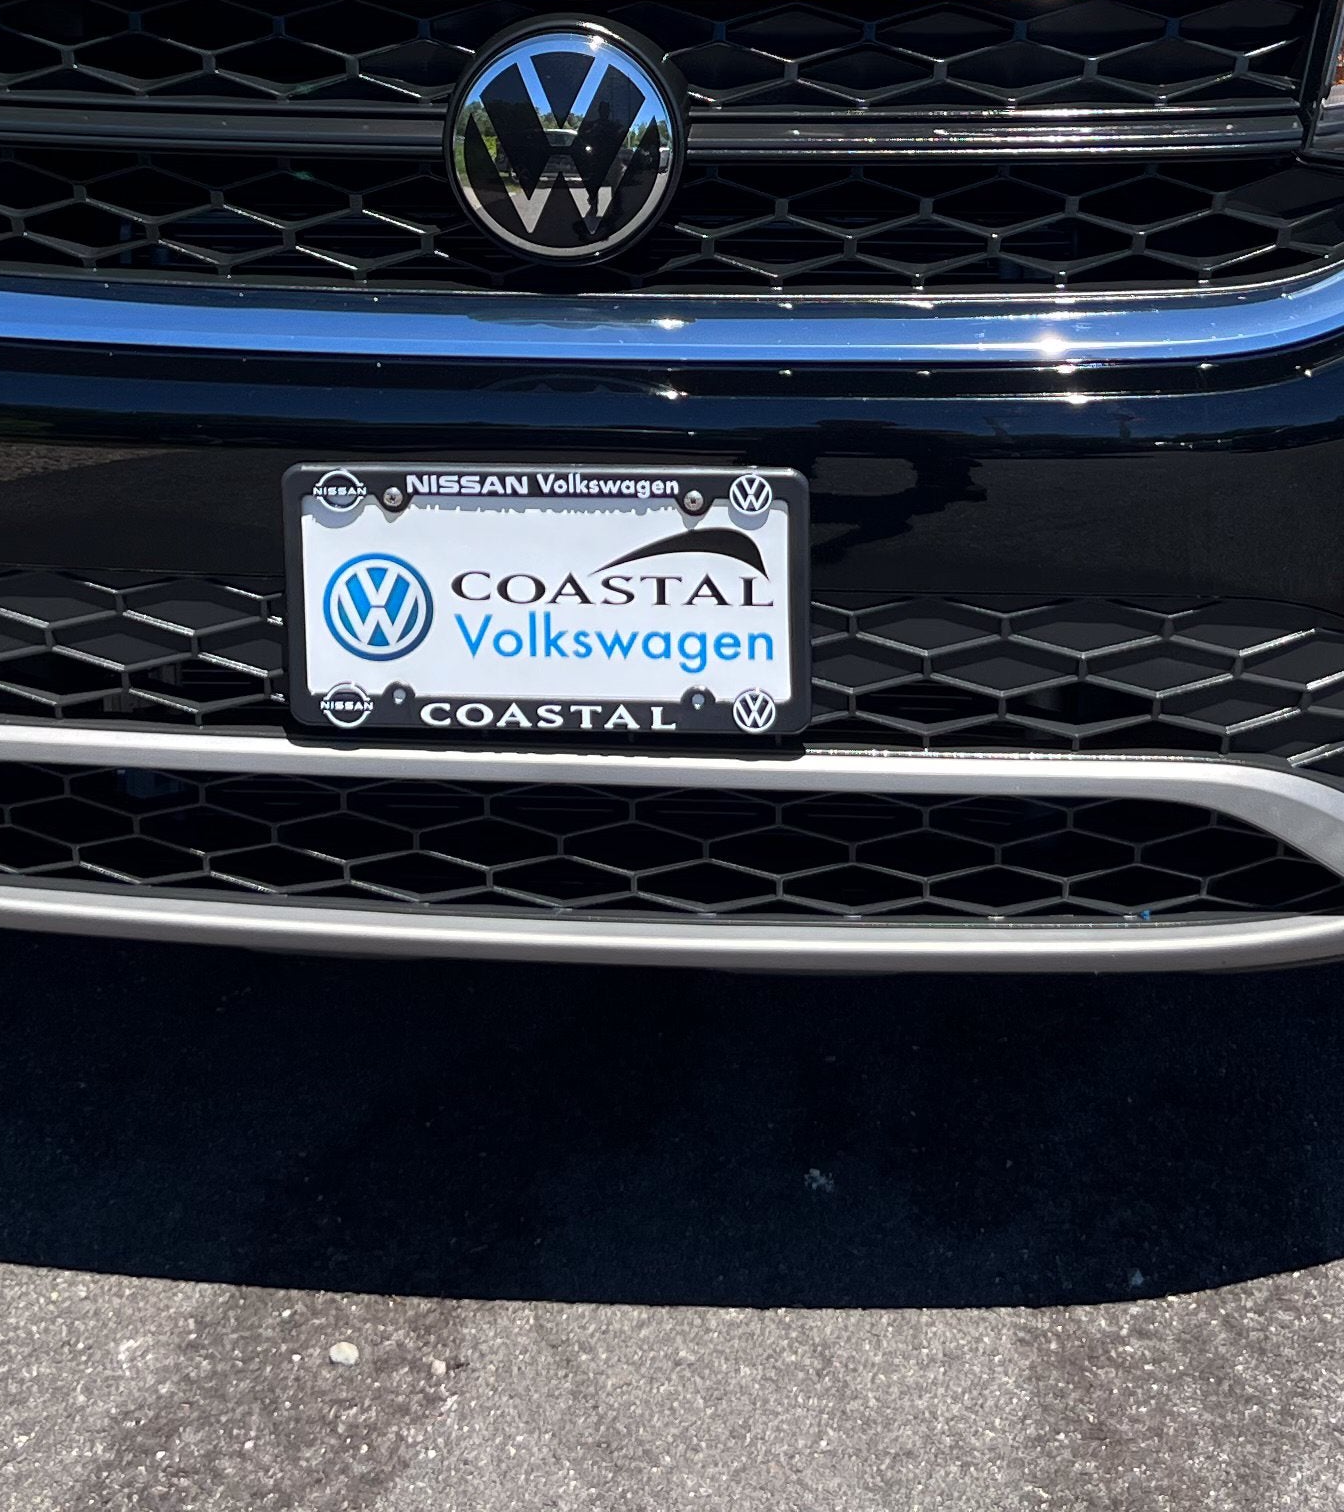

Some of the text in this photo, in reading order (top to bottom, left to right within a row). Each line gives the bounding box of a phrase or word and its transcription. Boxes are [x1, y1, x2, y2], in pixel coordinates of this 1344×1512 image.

[312, 485, 367, 496] NISSAN
[406, 472, 680, 498] NISSAN Volkswagen
[450, 571, 775, 608] COASTAL
[454, 611, 775, 674] Volkswagen
[320, 700, 374, 712] NISSAN
[420, 702, 677, 731] COASTAL
